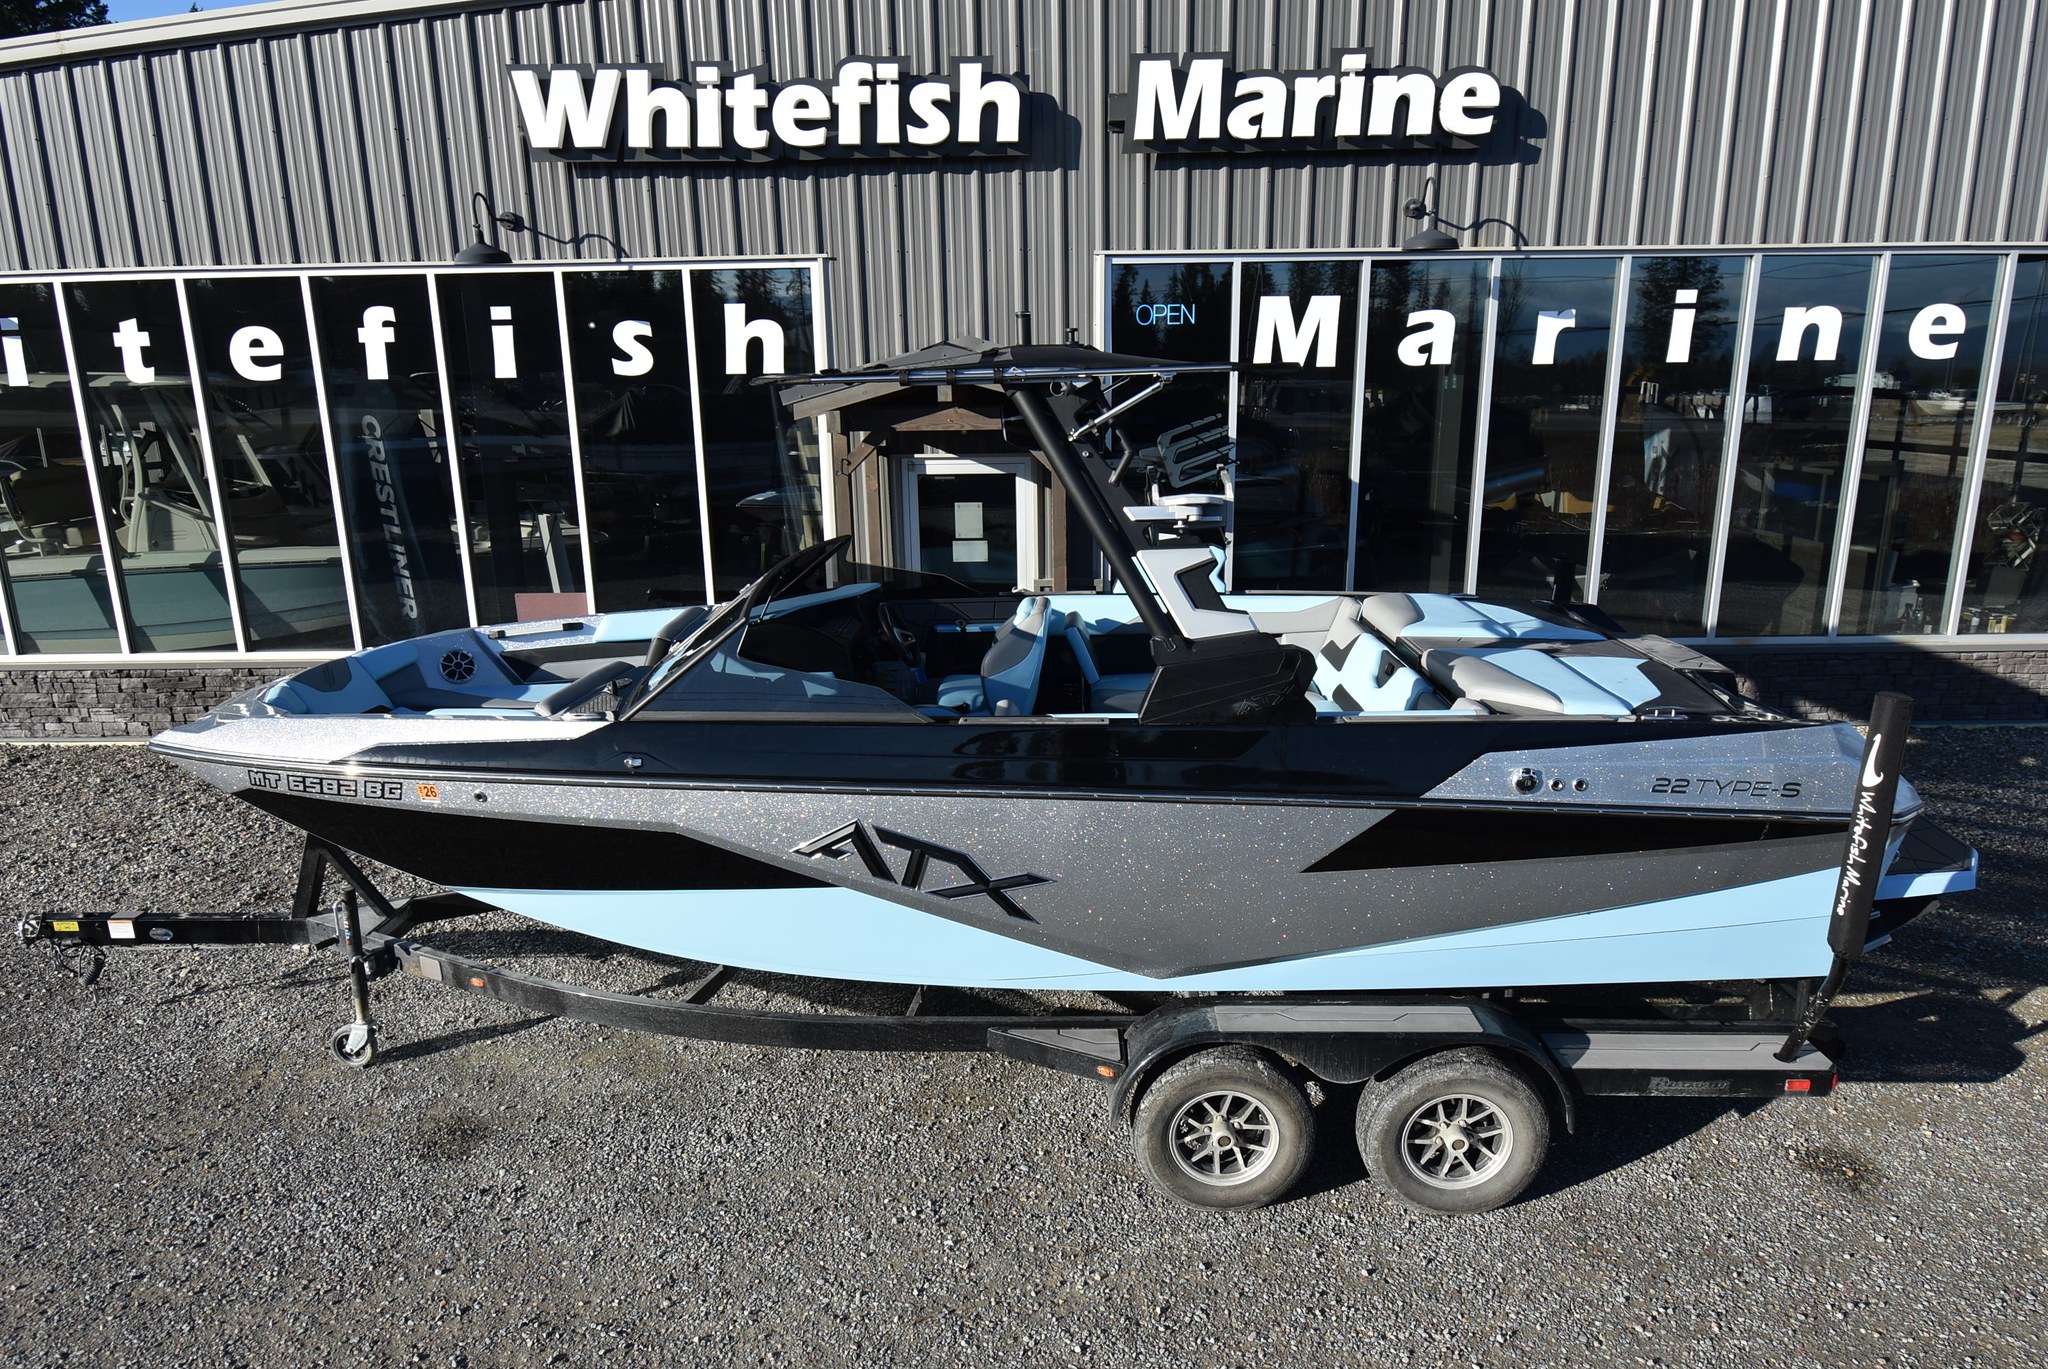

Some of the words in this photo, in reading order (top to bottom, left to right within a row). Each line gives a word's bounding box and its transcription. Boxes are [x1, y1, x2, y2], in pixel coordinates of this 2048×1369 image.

[511, 60, 1021, 150] Whitefish
[1133, 53, 1501, 141] Marine
[1136, 304, 1196, 326] OPEN
[361, 413, 418, 620] CRESTLINER
[248, 770, 281, 789] MT
[287, 775, 358, 797] 6582
[364, 780, 403, 801] BG
[423, 785, 437, 798] 26
[1652, 777, 1690, 794] 22
[1696, 779, 1802, 799] TYPE-S
[1847, 791, 1877, 866] Whitefish
[1836, 865, 1861, 917] Marine
